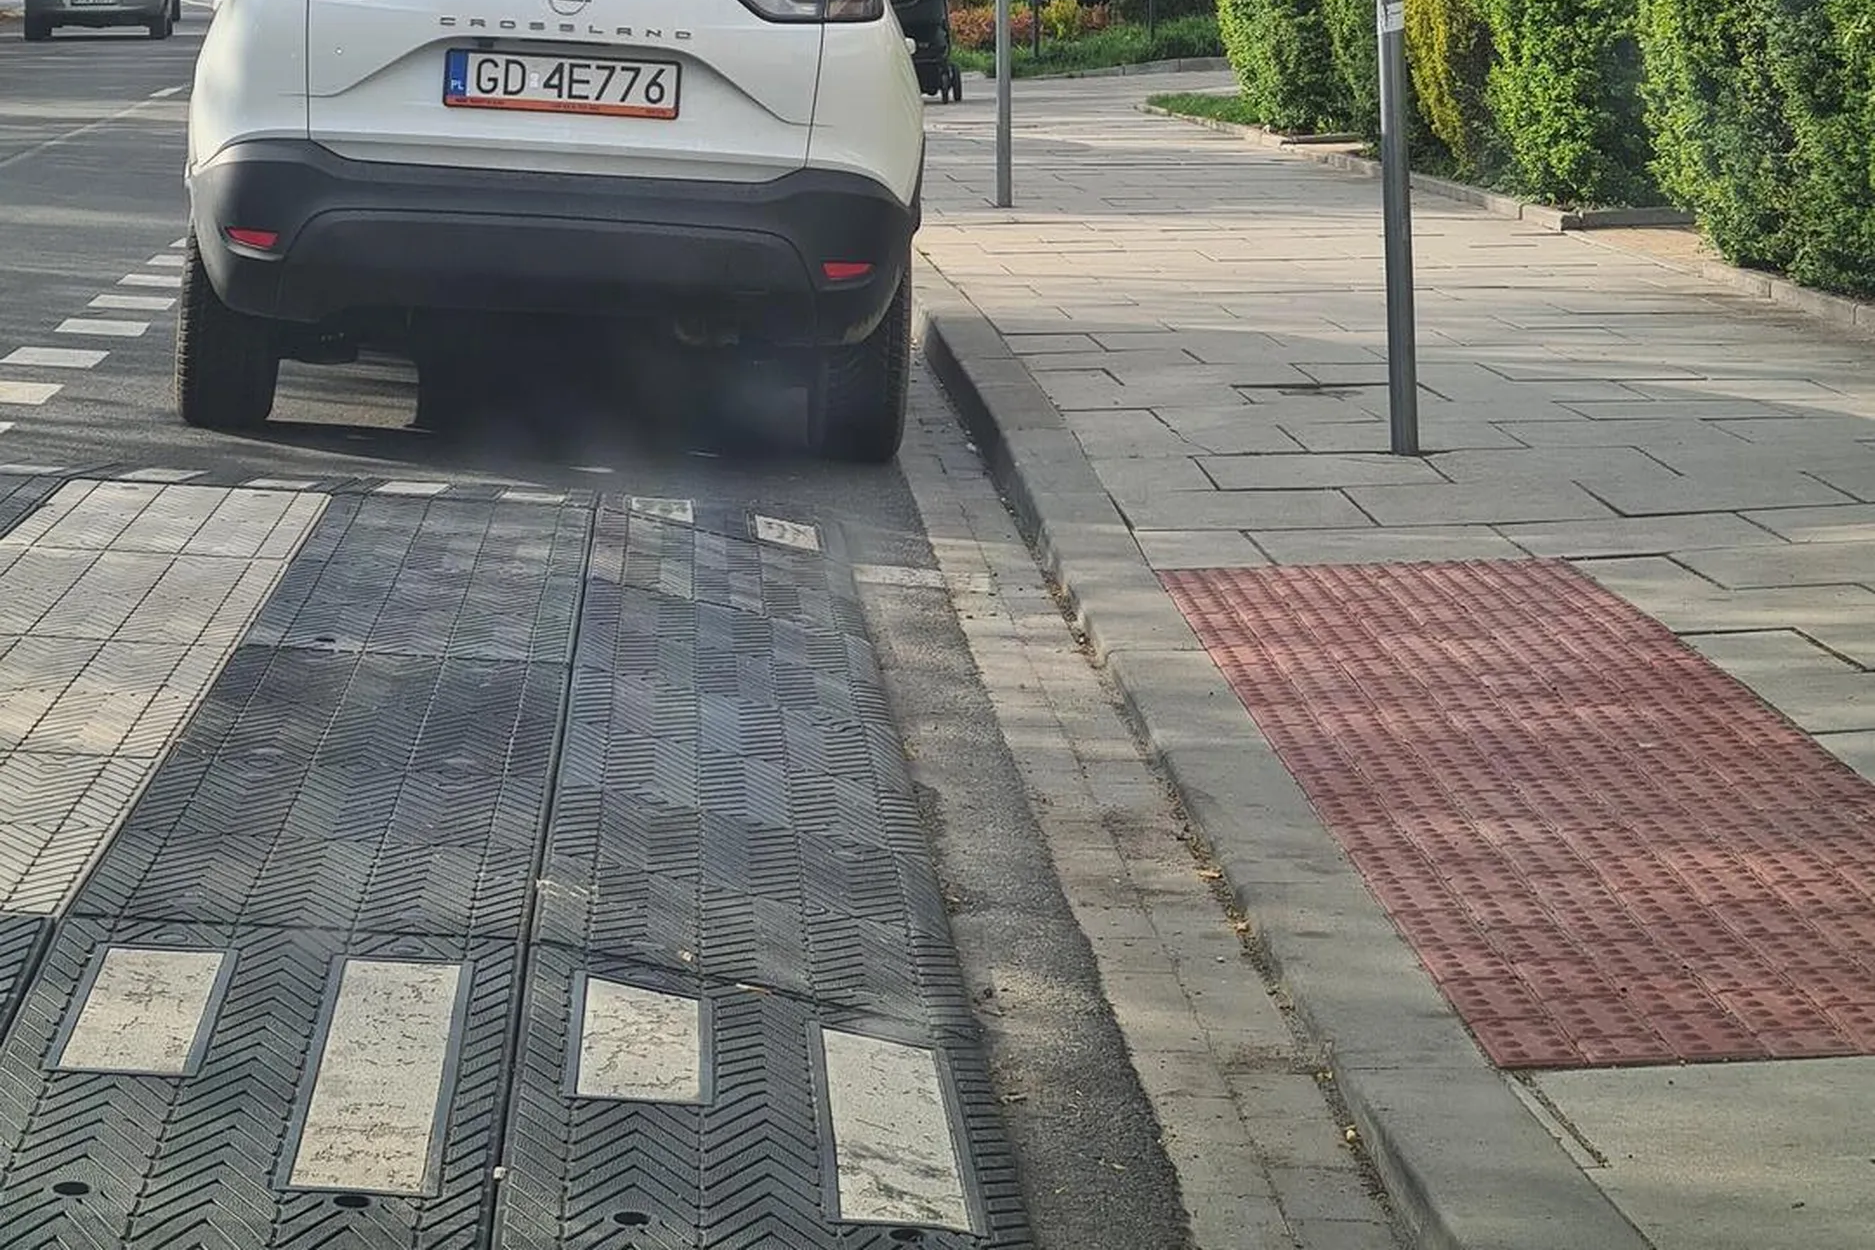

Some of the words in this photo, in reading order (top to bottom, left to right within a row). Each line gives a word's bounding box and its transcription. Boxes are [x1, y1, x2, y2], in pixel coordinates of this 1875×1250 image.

[440, 16, 693, 41] CROSSLAND
[450, 78, 465, 91] PL
[476, 58, 526, 96] GD
[542, 61, 666, 104] 4E776
